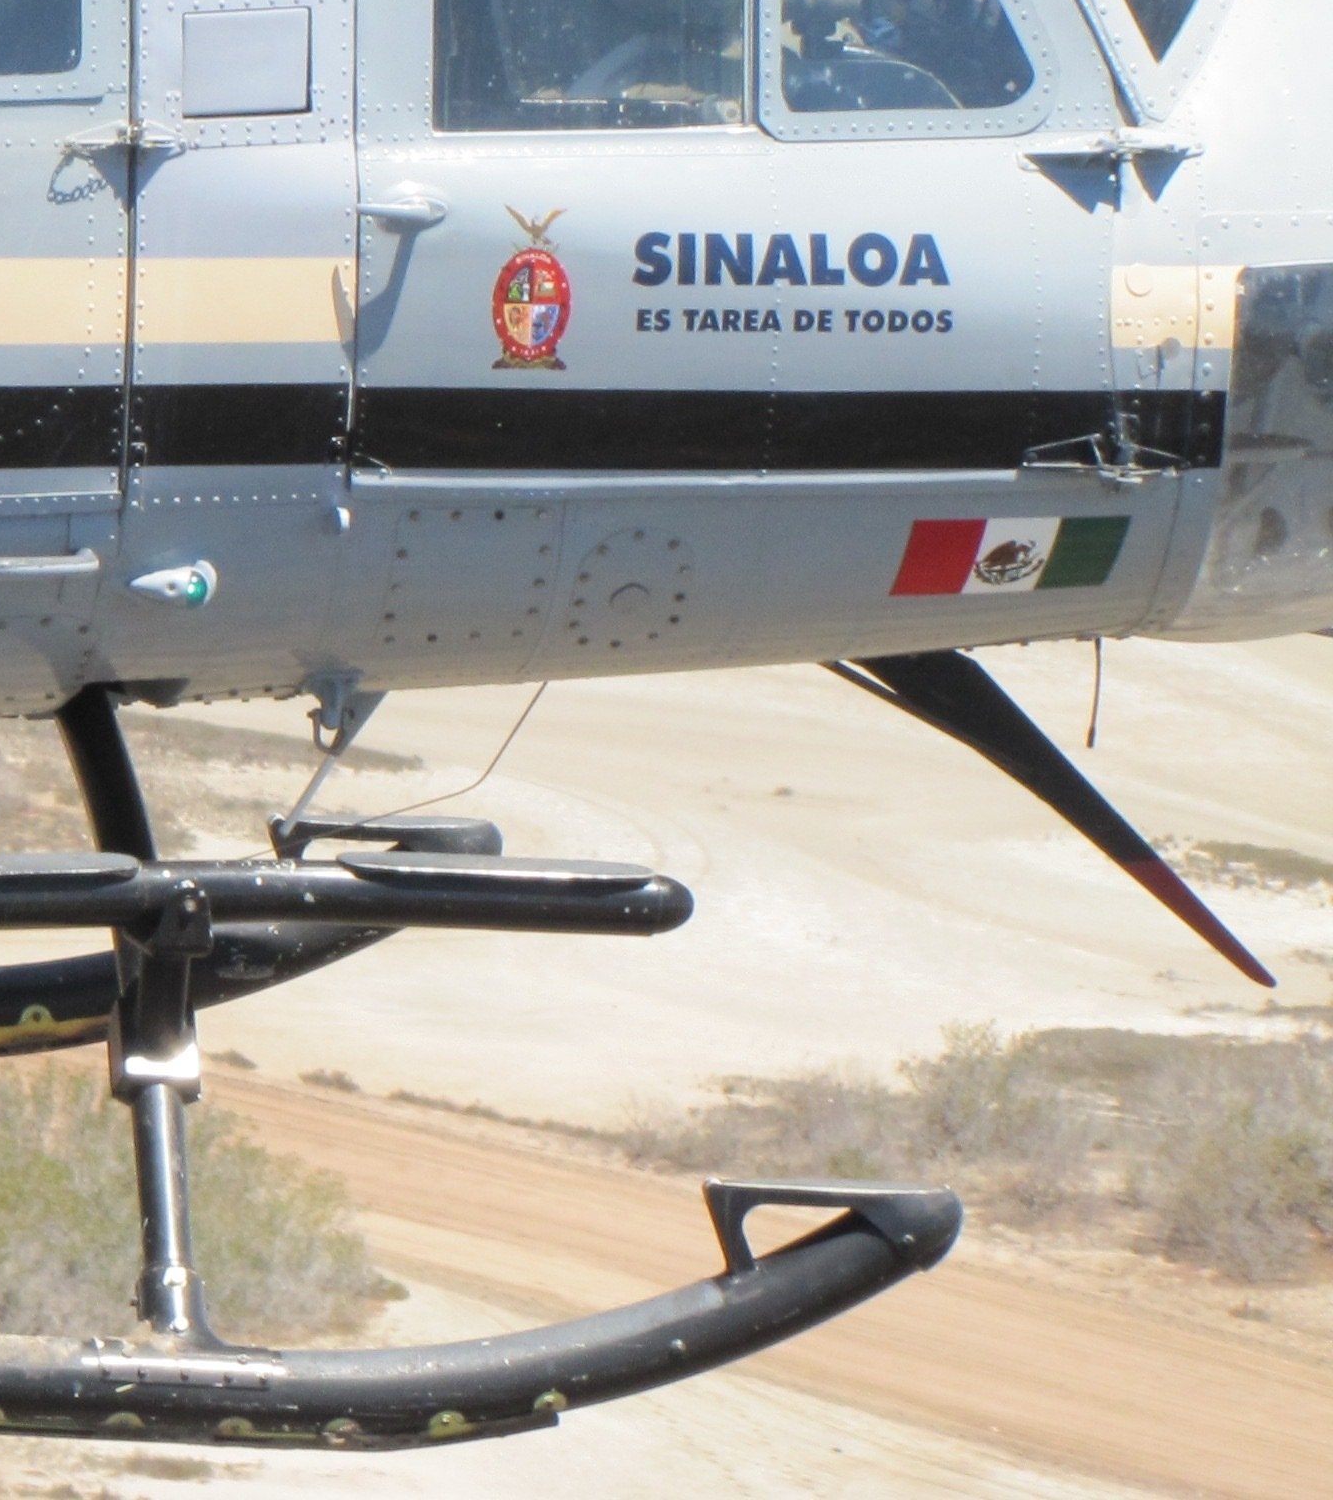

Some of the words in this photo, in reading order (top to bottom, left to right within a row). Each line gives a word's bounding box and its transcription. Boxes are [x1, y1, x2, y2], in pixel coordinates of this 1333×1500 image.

[632, 231, 950, 287] SINALOA
[636, 309, 671, 332] ES
[683, 309, 782, 332] TAREA
[793, 310, 832, 332] DE
[845, 310, 953, 333] TODOS
